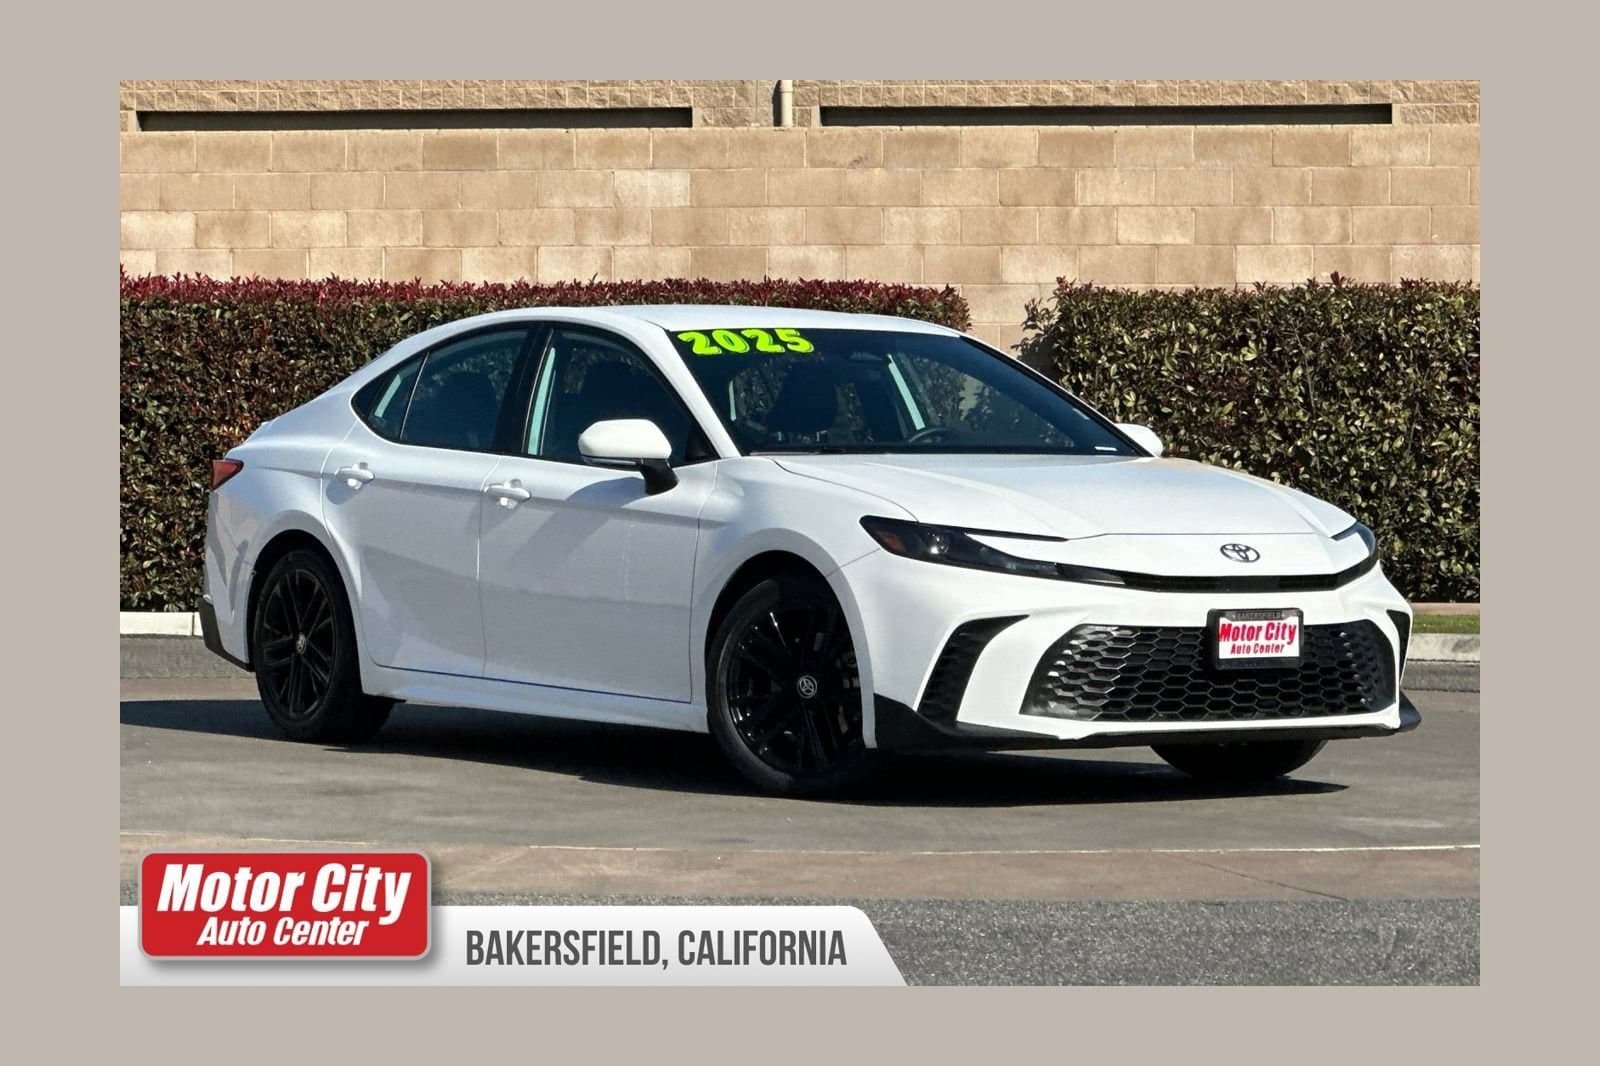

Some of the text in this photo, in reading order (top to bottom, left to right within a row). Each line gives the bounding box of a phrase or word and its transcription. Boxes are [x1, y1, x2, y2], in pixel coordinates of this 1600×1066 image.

[678, 328, 814, 355] 2025
[1218, 622, 1297, 645] Motor City
[1231, 642, 1285, 655] Auto Center
